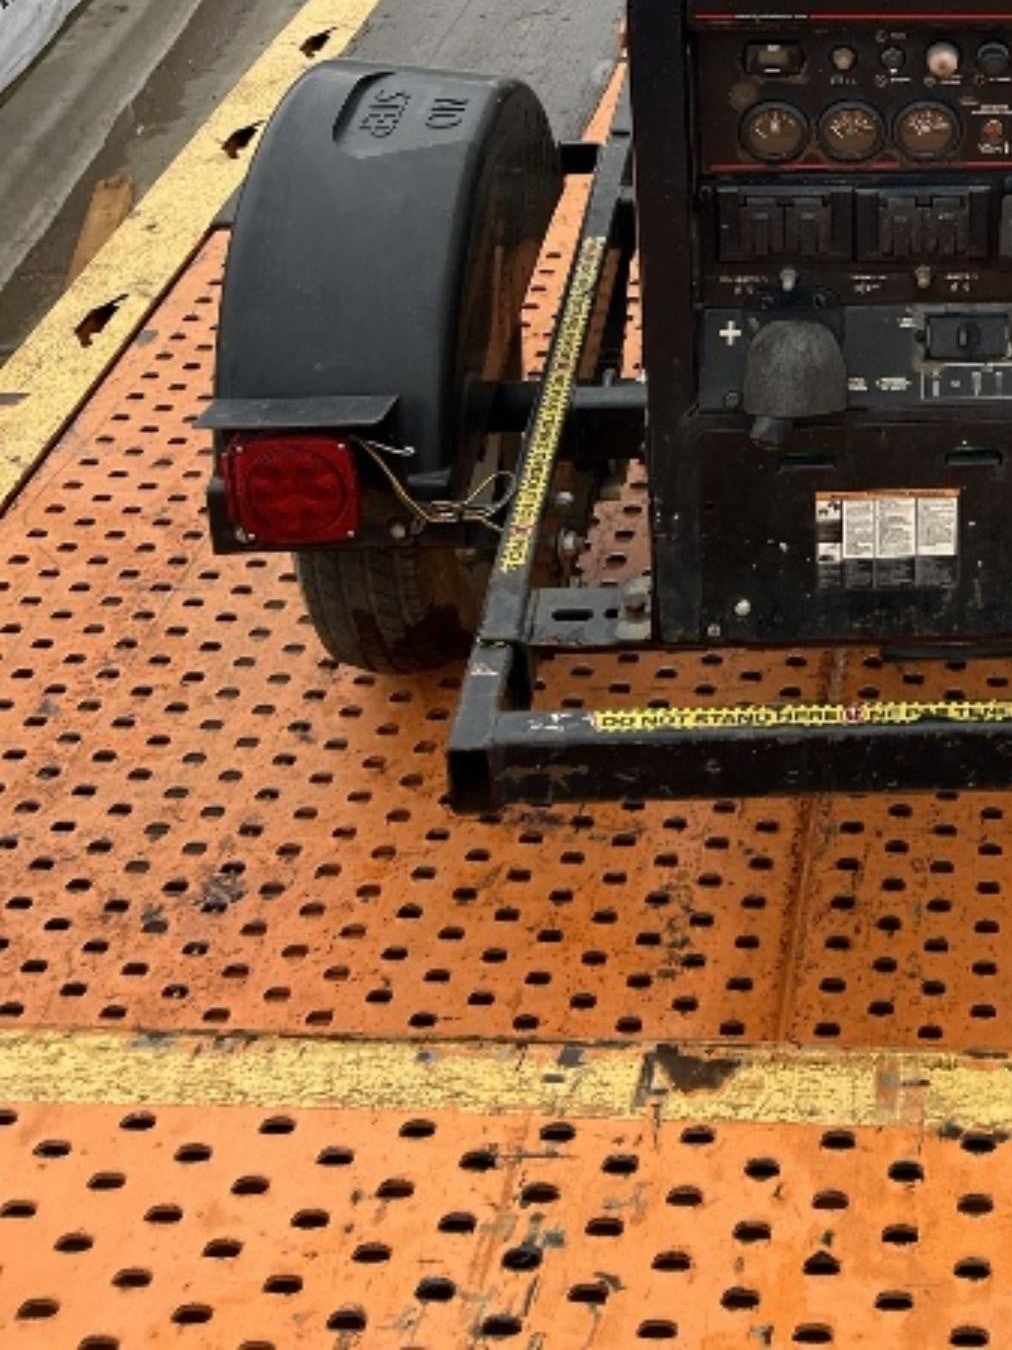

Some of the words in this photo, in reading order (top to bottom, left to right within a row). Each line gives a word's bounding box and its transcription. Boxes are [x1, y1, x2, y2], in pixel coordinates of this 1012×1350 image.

[357, 88, 412, 139] STEP
[425, 97, 470, 130] NO
[602, 715, 634, 727] DO
[641, 713, 685, 727] NOT
[694, 711, 772, 725] STAND
[775, 707, 838, 722] HERE
